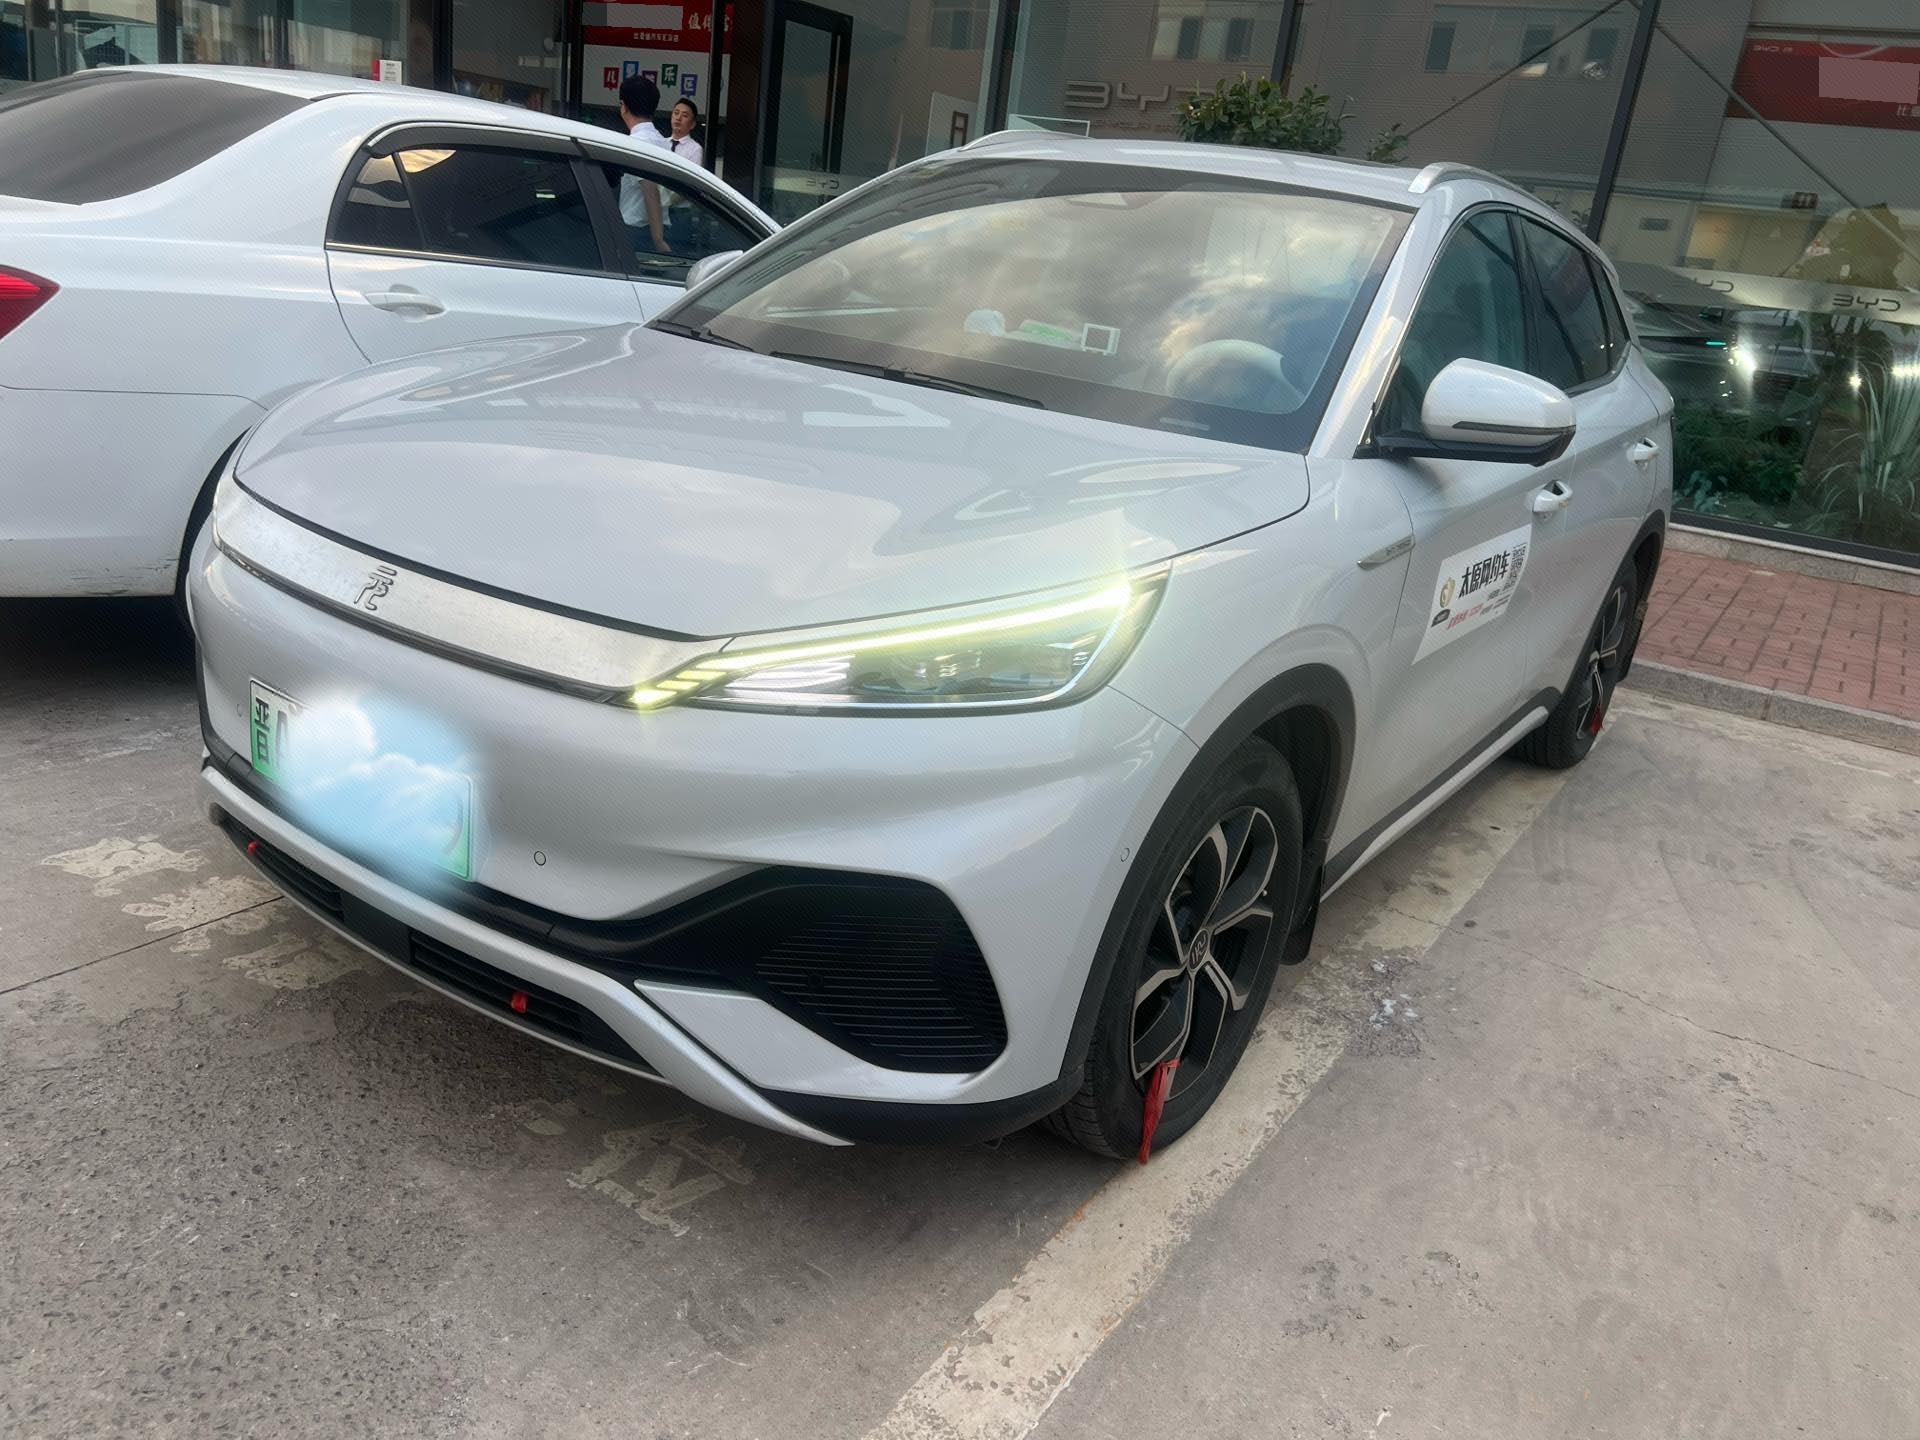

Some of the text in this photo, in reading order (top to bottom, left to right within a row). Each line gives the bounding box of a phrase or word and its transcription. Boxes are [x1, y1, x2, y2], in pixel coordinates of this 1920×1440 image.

[1832, 293, 1901, 312] BYD
[1458, 550, 1511, 599] 太原网约车
